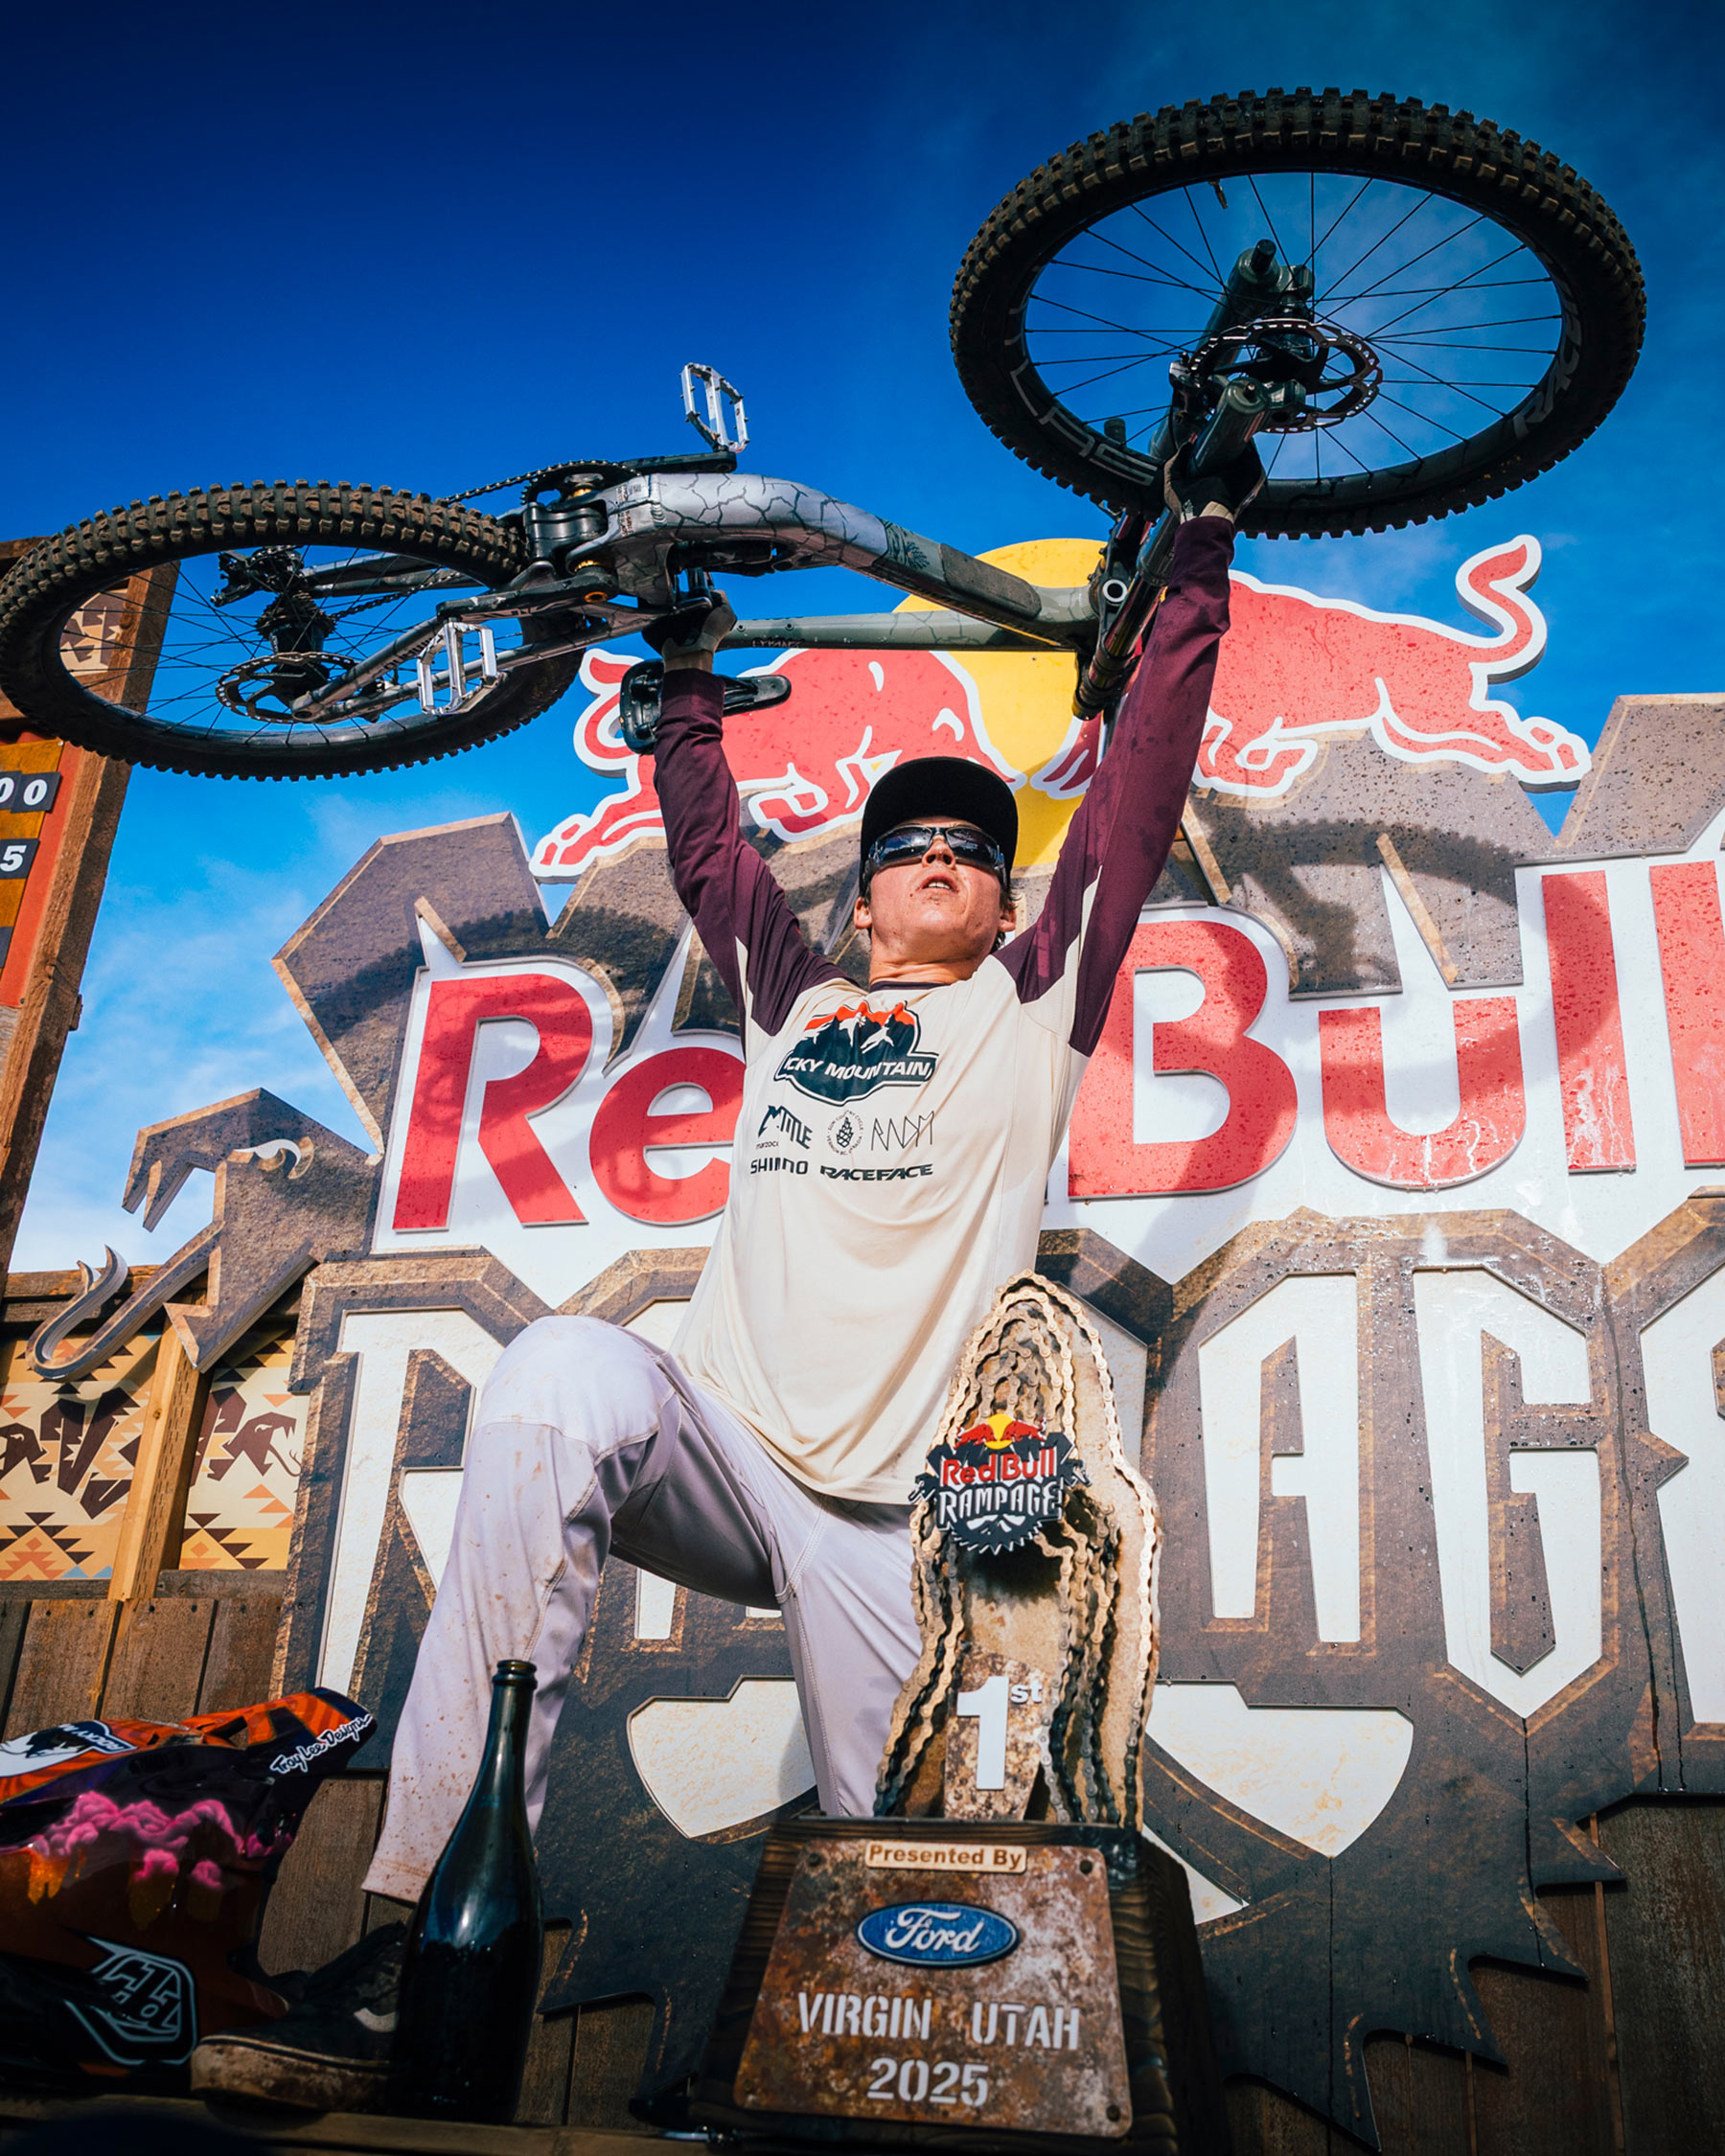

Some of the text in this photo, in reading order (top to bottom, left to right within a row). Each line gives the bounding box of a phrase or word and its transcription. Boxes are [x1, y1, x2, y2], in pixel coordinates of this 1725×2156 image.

[0, 845, 27, 872] 5
[392, 860, 1725, 1233] Re Bull
[783, 1057, 931, 1080] CKY MOUNTAIN
[749, 1157, 809, 1176] SHINO
[819, 1164, 934, 1181] RACEFACE
[942, 1447, 1055, 1486] Red Bull
[938, 1480, 1059, 1525] RAMPAGE
[269, 1755, 309, 1774] Troy
[316, 1713, 374, 1743] Designs
[868, 1844, 1024, 1870] Presented By
[884, 1907, 986, 1952] Ford
[798, 1992, 1080, 2051] VIRGIN UTAH
[866, 2057, 989, 2107] 2025
